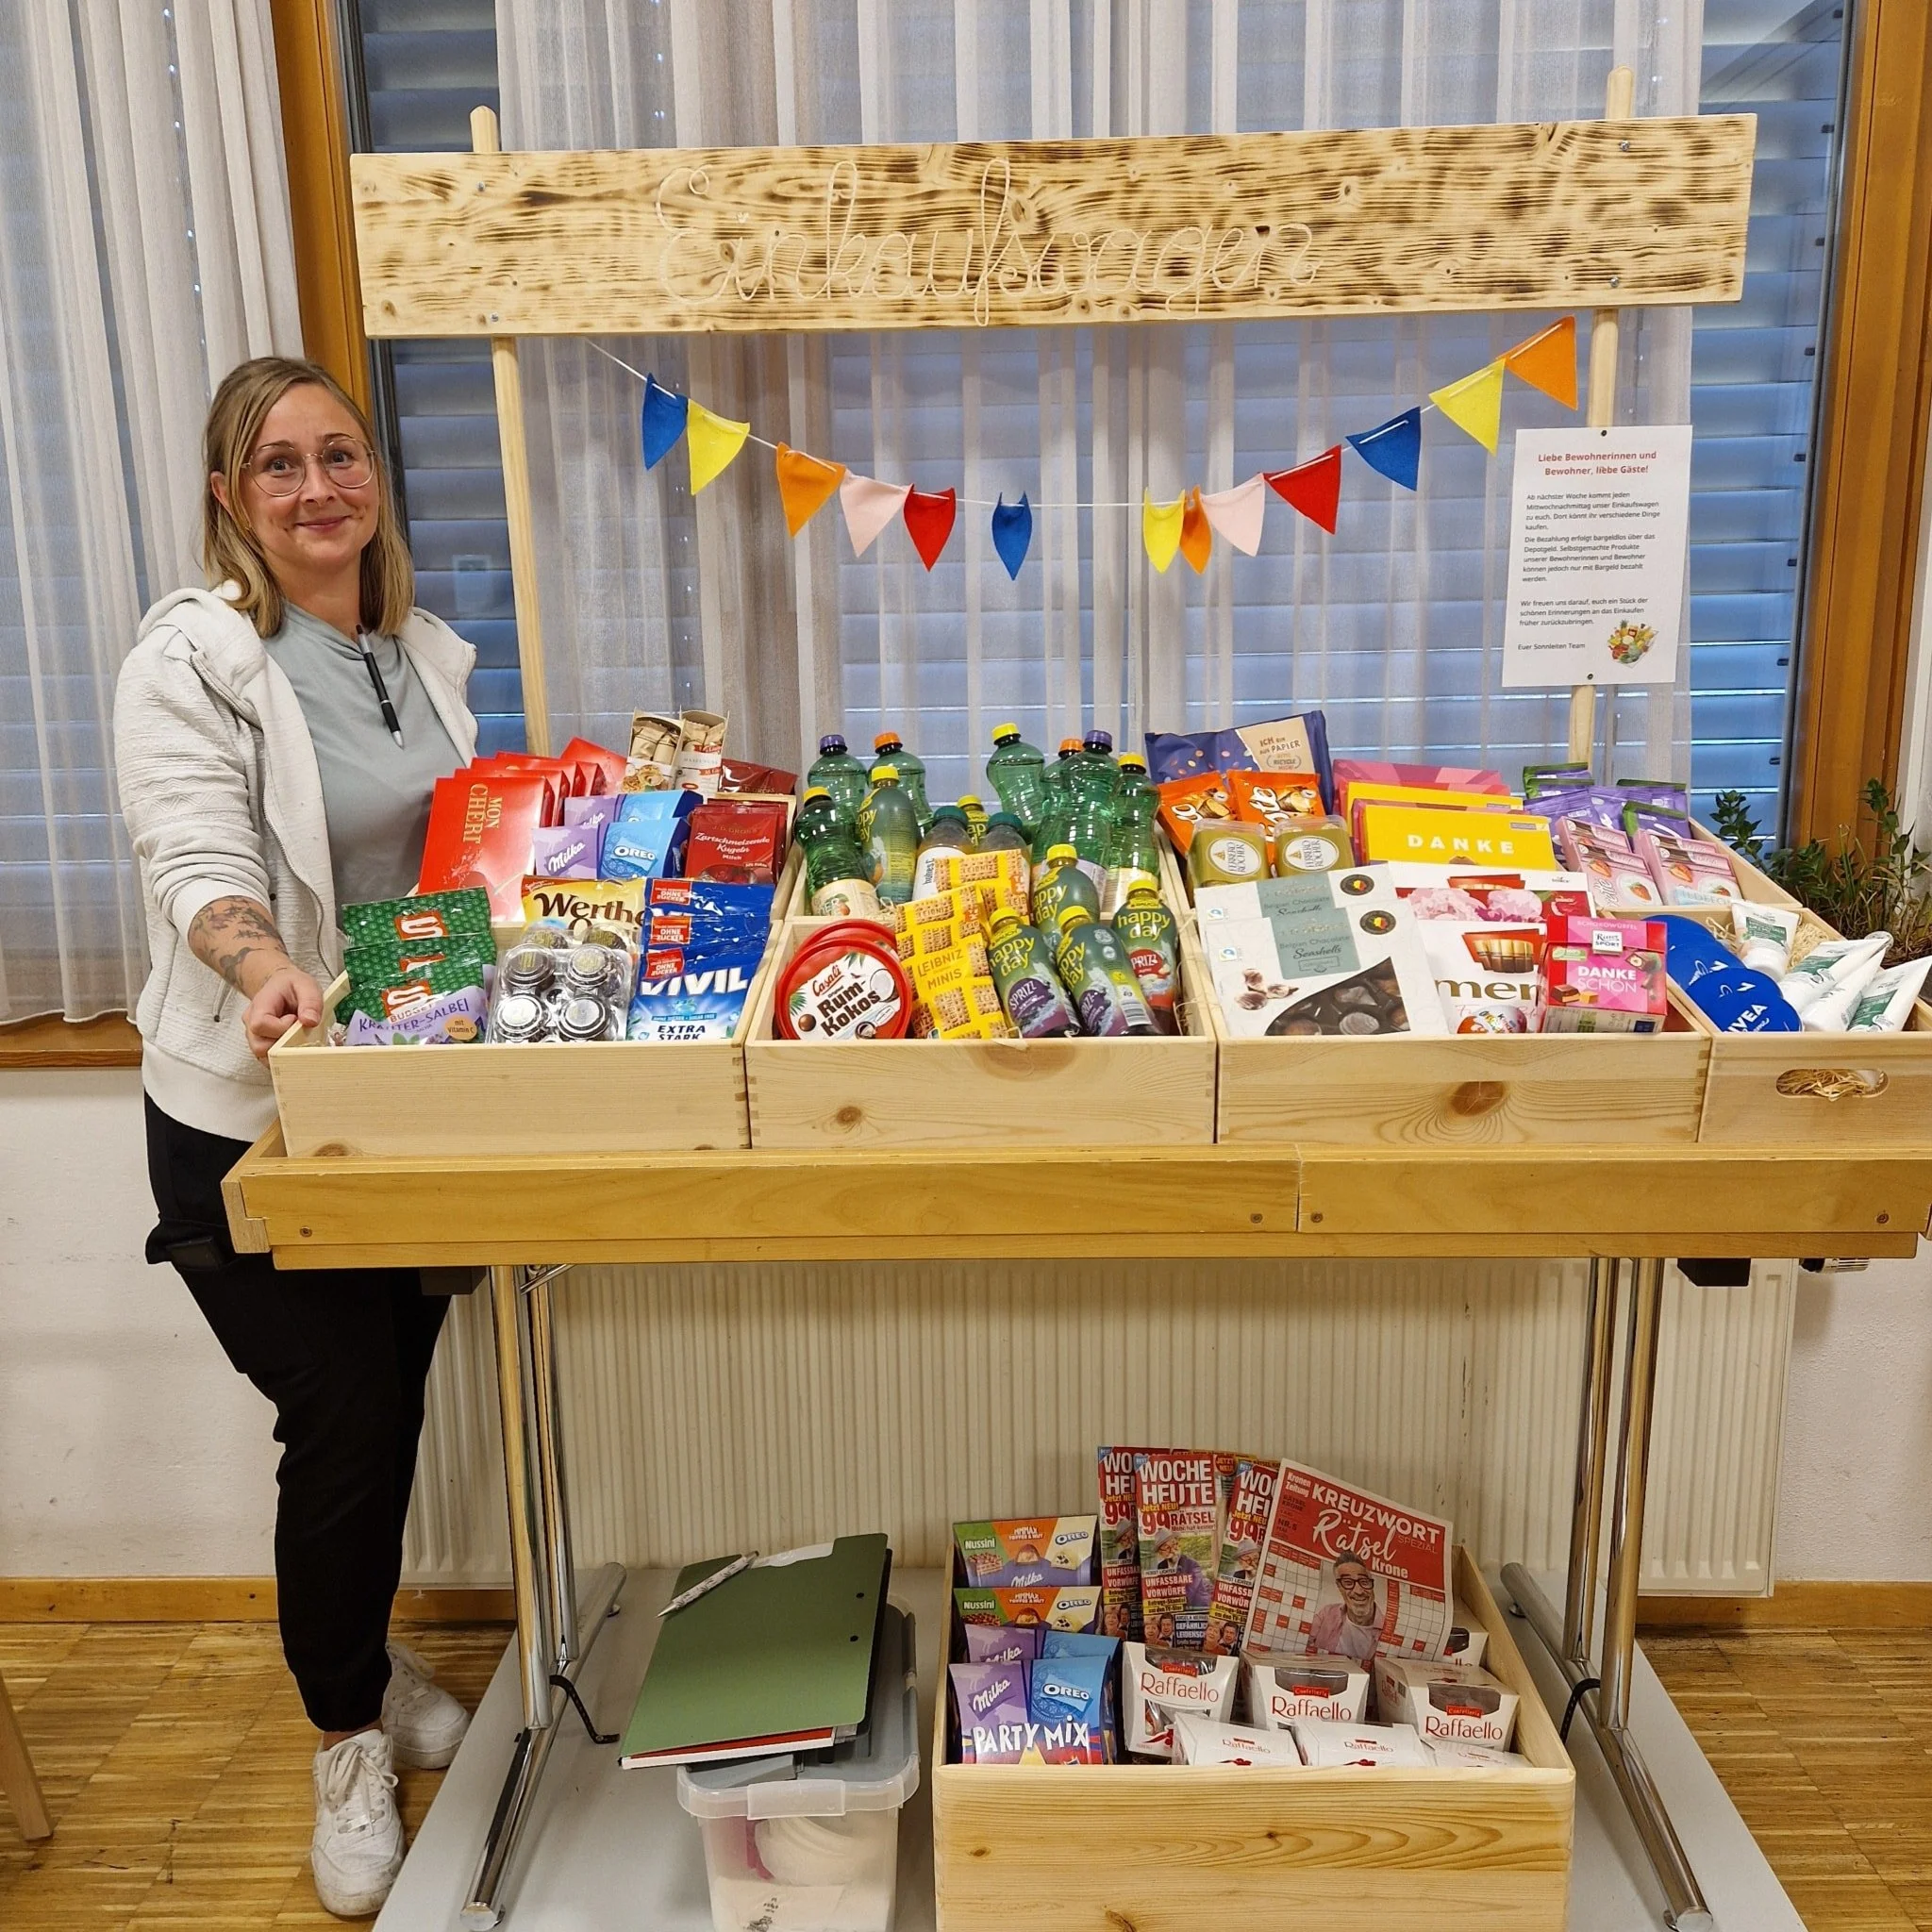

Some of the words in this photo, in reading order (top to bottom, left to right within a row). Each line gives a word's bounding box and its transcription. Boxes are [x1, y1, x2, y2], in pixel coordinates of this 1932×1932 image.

[655, 158, 1320, 327] Einkaufswagen
[1538, 453, 1562, 462] Liebe
[1566, 453, 1637, 461] Bewohnerinnen
[1640, 451, 1657, 459] und
[1545, 467, 1593, 475] Bewohner,
[1621, 465, 1649, 474] Gäste!
[1612, 491, 1630, 500] jeden
[1526, 503, 1591, 511] Mittwochnachmittag
[1611, 501, 1659, 509] Einkaufswagen
[1536, 536, 1570, 544] Bezahlung
[1571, 534, 1592, 542] erfolgt
[1524, 545, 1557, 554] Depotgeld.
[1560, 544, 1609, 553] Selbstgemachte
[1547, 564, 1569, 574] jedoch
[1568, 598, 1591, 607] darauf,
[1548, 608, 1591, 617] Erinnerungen
[1540, 617, 1594, 626] zurückzubringen.
[1259, 737, 1274, 747] ICH
[1272, 740, 1301, 753] PAPIER
[485, 797, 503, 828] MON
[694, 832, 770, 845] Zartschmelzende
[1407, 834, 1515, 855] DANKE
[548, 841, 585, 873] Milka
[615, 846, 656, 860] OREO
[716, 843, 750, 855] Kugeln
[657, 894, 686, 903] ZUCKER
[1117, 911, 1171, 928] happy
[1129, 924, 1162, 941] day
[1309, 936, 1350, 945] Chocolate
[1292, 945, 1342, 959] Seashells
[651, 967, 677, 975] ZUCKER
[917, 949, 964, 977] LEIBNIZ
[1001, 953, 1028, 976] day
[641, 966, 749, 996] VIVIL
[813, 964, 841, 996] Casali
[926, 968, 962, 991] MINIS
[1577, 966, 1637, 980] DANKE
[1577, 977, 1637, 993] SCHÖN
[817, 981, 866, 1018] Rum-
[821, 991, 881, 1037] Kokos
[657, 1024, 706, 1034] EXTRA
[1104, 1453, 1133, 1474] WO
[1140, 1460, 1212, 1482] WOCHE
[1241, 1470, 1277, 1497] WO
[1288, 1472, 1311, 1488] Kronen
[1141, 1483, 1214, 1505] HEUTE
[1286, 1481, 1309, 1498] Zeitung
[1104, 1494, 1122, 1503] Jetzt
[1104, 1502, 1130, 1524] 99
[1141, 1504, 1160, 1513] Jetzt
[1161, 1502, 1178, 1510] NEU!
[1232, 1509, 1251, 1521] Jetzt
[1311, 1483, 1441, 1543] KREUZWORT
[1141, 1511, 1171, 1536] 99
[1171, 1510, 1214, 1525] RÄTSEL
[1229, 1518, 1257, 1541] 99
[1312, 1509, 1397, 1562] Rätsel
[964, 1538, 995, 1550] Nussini
[1055, 1532, 1088, 1545] OREO
[1397, 1534, 1438, 1554] SPEZIAL
[1372, 1557, 1408, 1579] Krone
[1011, 1571, 1043, 1587] Milka
[1145, 1574, 1192, 1588] UNFASSBARE
[1147, 1586, 1187, 1598] VORWÜRFE
[964, 1600, 994, 1609] Nussini
[1057, 1598, 1091, 1609] OREO
[973, 1678, 1011, 1712] Milka
[1043, 1684, 1090, 1700] OREO
[1141, 1673, 1219, 1703] Raffaello
[1272, 1696, 1351, 1721] Raffaello
[1425, 1716, 1503, 1740] Raffaello
[973, 1723, 1040, 1753] PARTY
[1223, 1739, 1271, 1754] Raffaello
[1344, 1741, 1393, 1753] Raffaello
